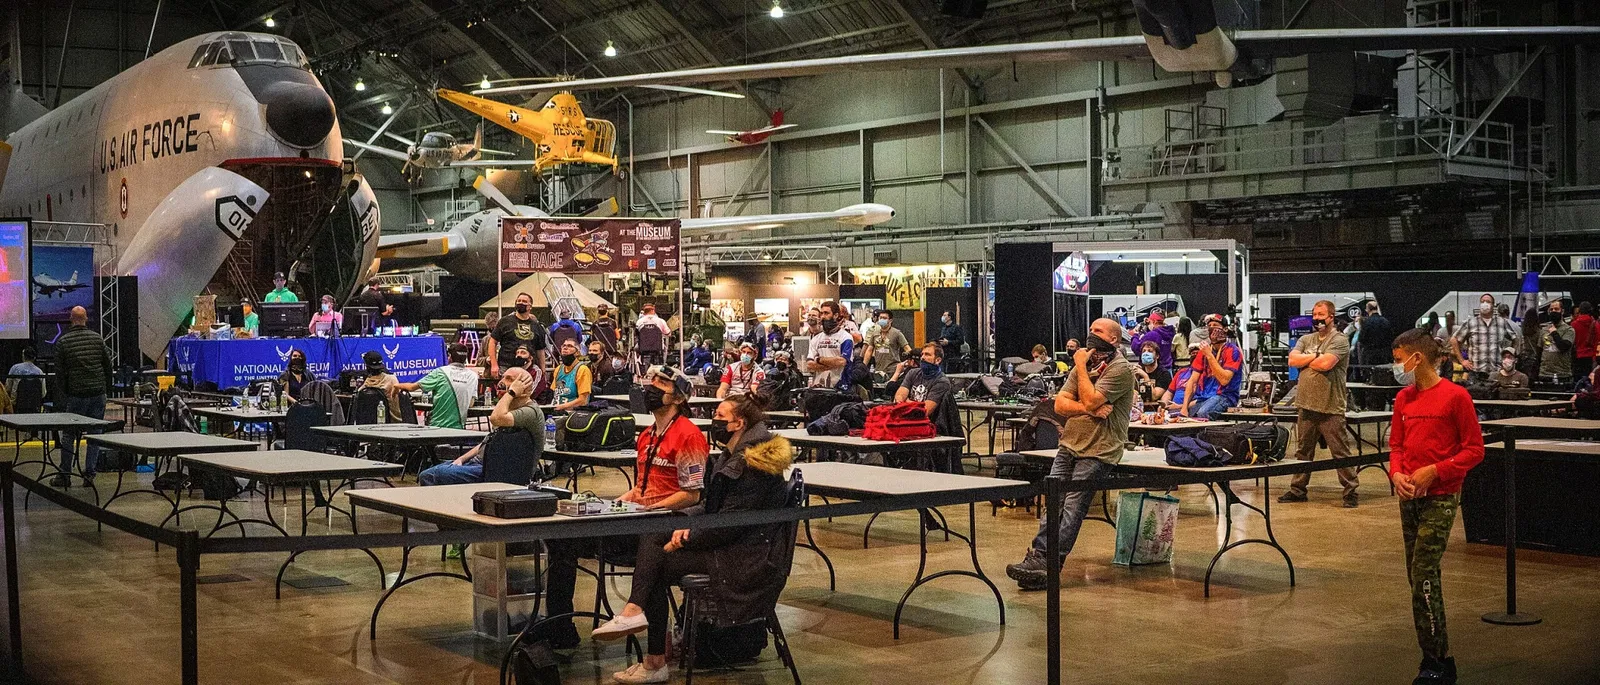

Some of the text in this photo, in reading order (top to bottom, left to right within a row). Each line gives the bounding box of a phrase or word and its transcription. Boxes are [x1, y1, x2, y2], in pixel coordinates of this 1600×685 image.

[142, 112, 200, 161] FORCE
[553, 122, 585, 138] RESCUE
[635, 226, 671, 237] MUSEUM
[530, 252, 564, 268] RACE
[234, 362, 330, 374] NATIONAL EUM
[394, 358, 437, 370] MUSEUM
